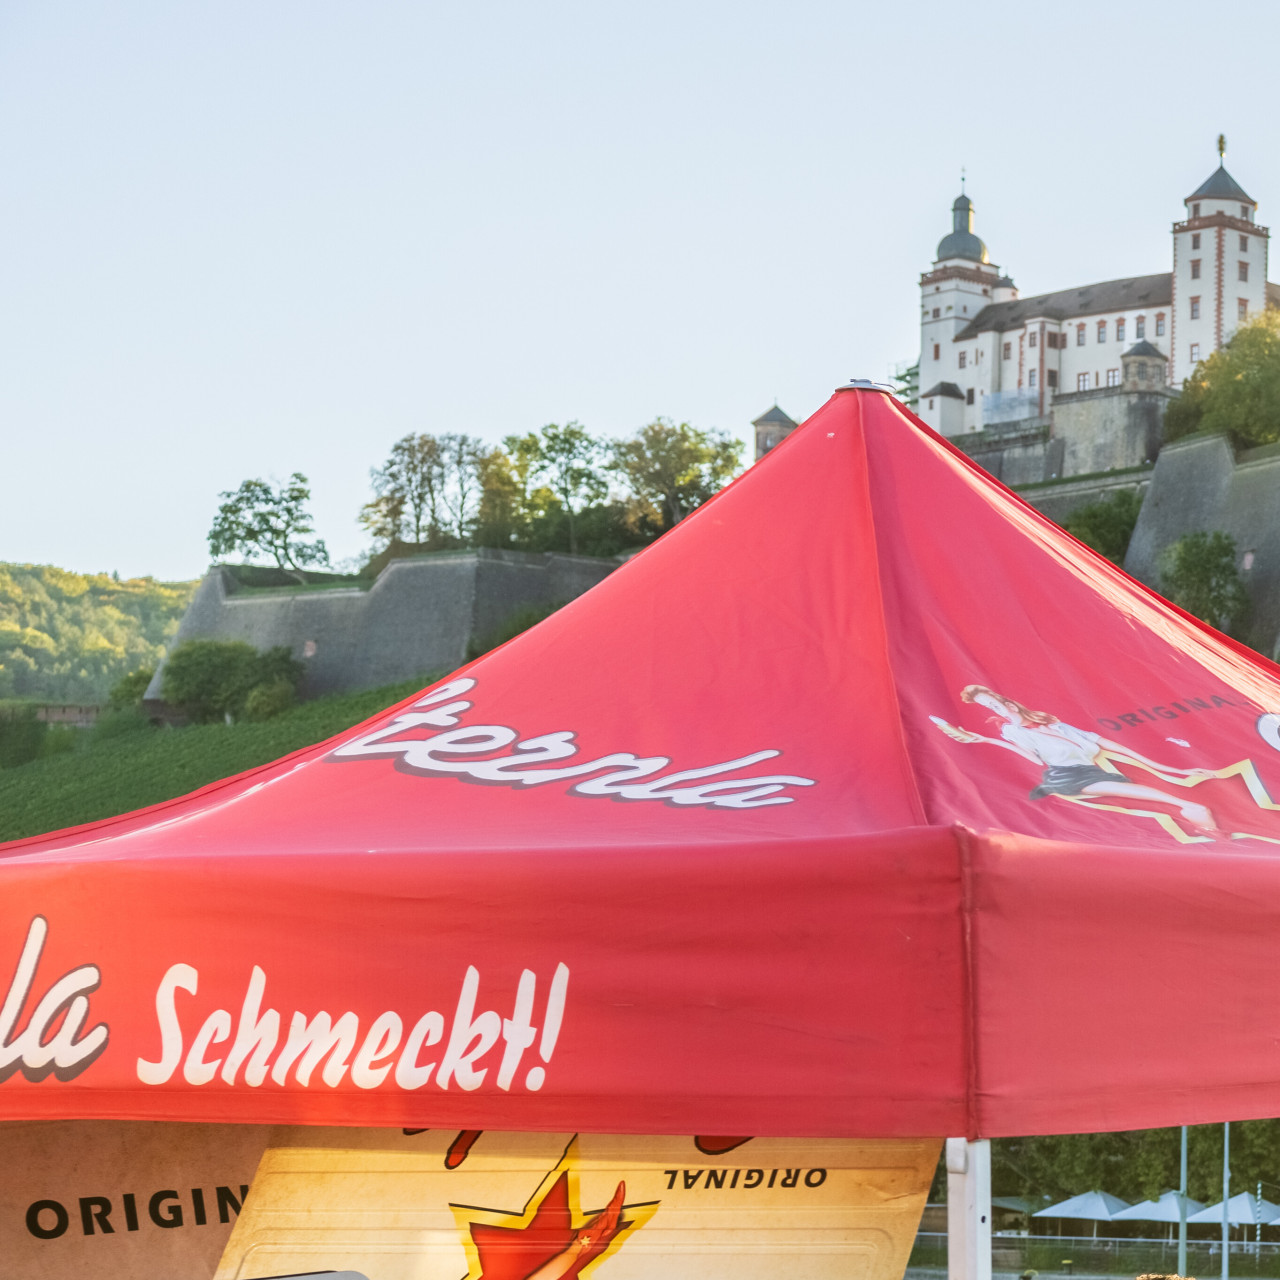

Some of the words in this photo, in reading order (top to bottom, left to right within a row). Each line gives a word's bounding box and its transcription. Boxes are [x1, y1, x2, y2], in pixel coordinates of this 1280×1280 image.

[1097, 692, 1248, 732] ORIGINA
[322, 677, 817, 809] ternla
[136, 961, 570, 1092] Schmeckt!
[663, 1166, 828, 1190] ORIGINAL
[25, 1184, 250, 1240] ORIGIN
